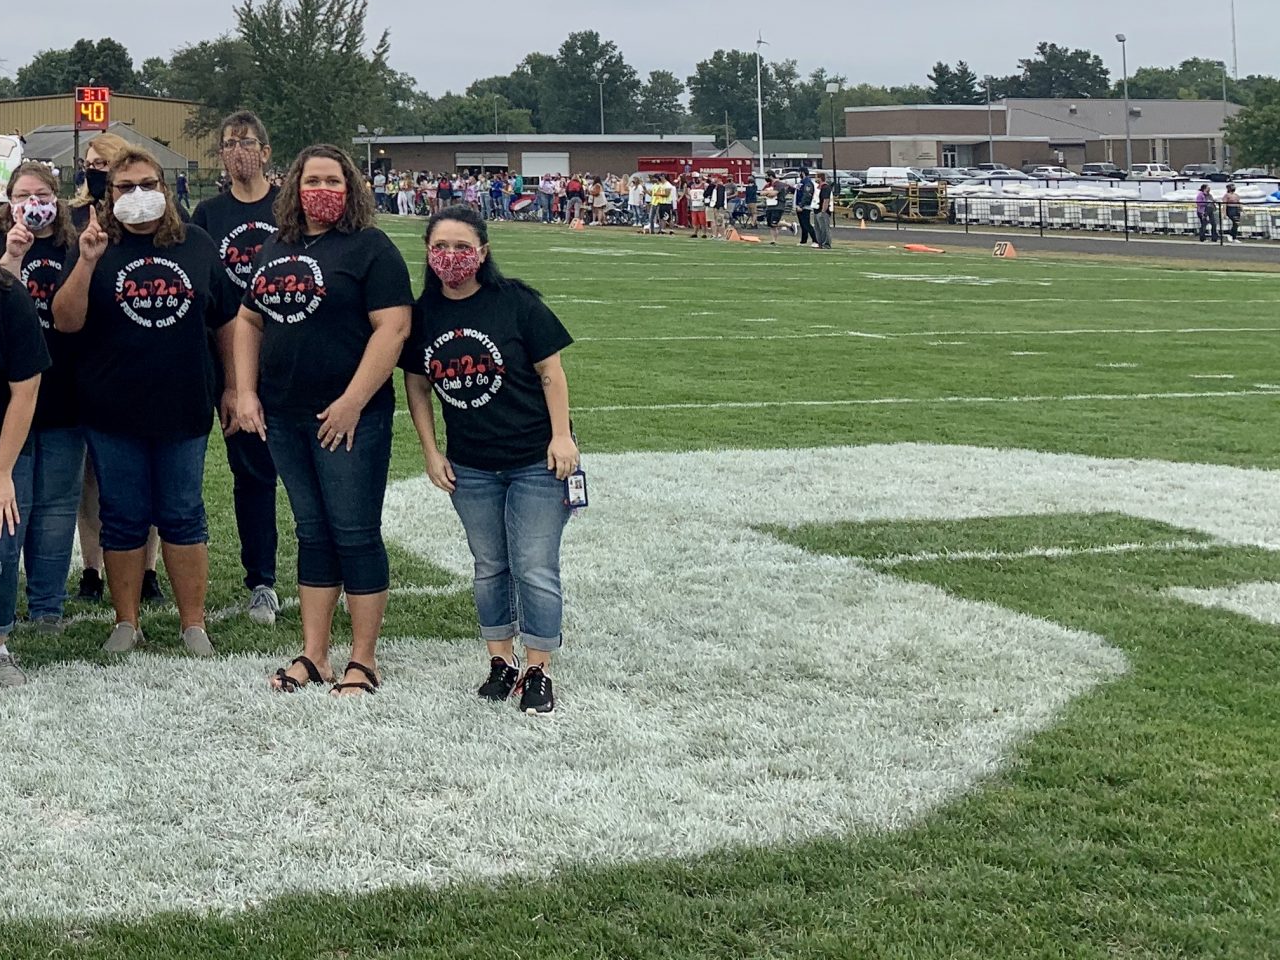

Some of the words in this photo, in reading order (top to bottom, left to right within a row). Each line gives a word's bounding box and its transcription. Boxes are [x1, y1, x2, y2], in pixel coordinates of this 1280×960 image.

[84, 89, 108, 100] 3:17
[81, 102, 104, 122] 40
[229, 223, 248, 239] STOP
[993, 243, 1008, 256] 20
[125, 258, 145, 272] STOP
[177, 269, 192, 289] STOP
[155, 296, 163, 308] &
[166, 295, 178, 307] Go
[295, 291, 306, 303] Go
[120, 301, 152, 328] FEEDING
[156, 315, 176, 327] OUR
[175, 298, 191, 318] KIDS
[287, 311, 306, 324] OUR
[306, 295, 322, 314] KIDS
[434, 331, 455, 348] STOP
[486, 342, 503, 366] STOP
[442, 376, 462, 390] Grab
[465, 375, 473, 388] &
[476, 373, 489, 385] Go
[471, 392, 491, 408] OUR
[489, 375, 502, 394] KIDS
